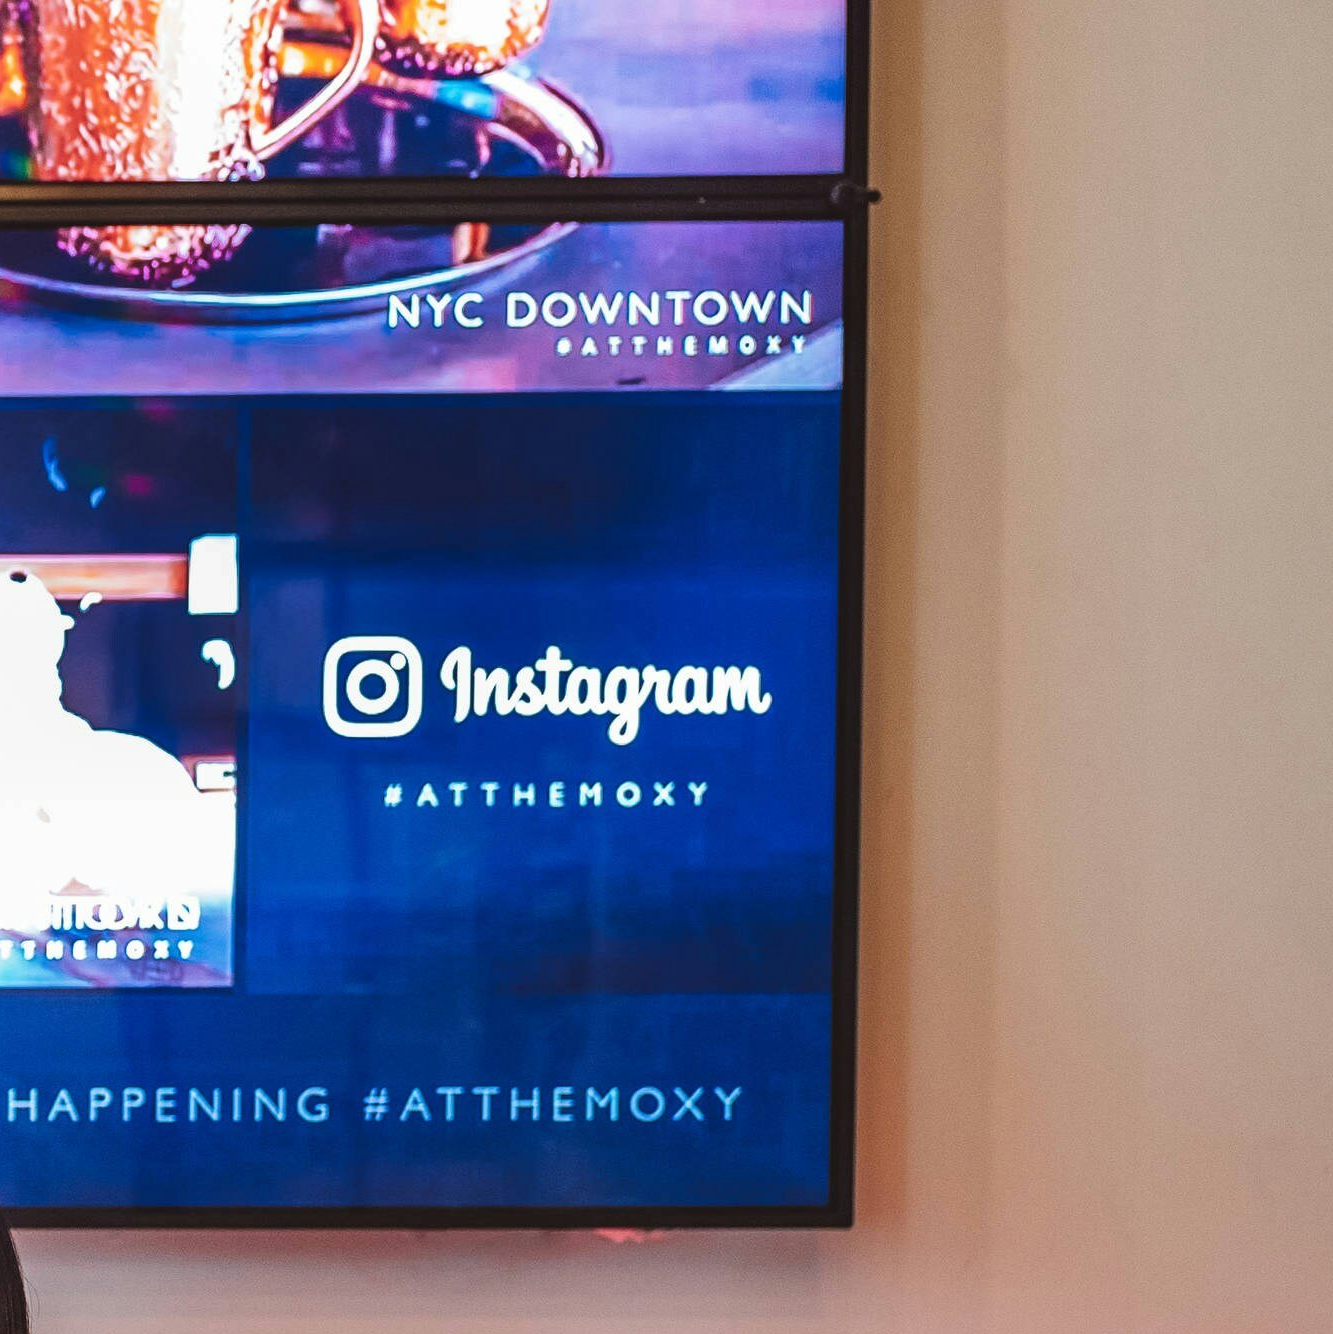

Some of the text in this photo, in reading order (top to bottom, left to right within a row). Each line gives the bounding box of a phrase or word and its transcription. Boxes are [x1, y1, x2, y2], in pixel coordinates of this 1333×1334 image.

[388, 290, 812, 328] NYC DOWNTOWN
[440, 645, 773, 746] Instagram
[383, 780, 709, 808] #ATTHEMOXY
[7, 1086, 330, 1124] HAPPENING
[363, 1086, 743, 1122] #ATTHEMOXY
